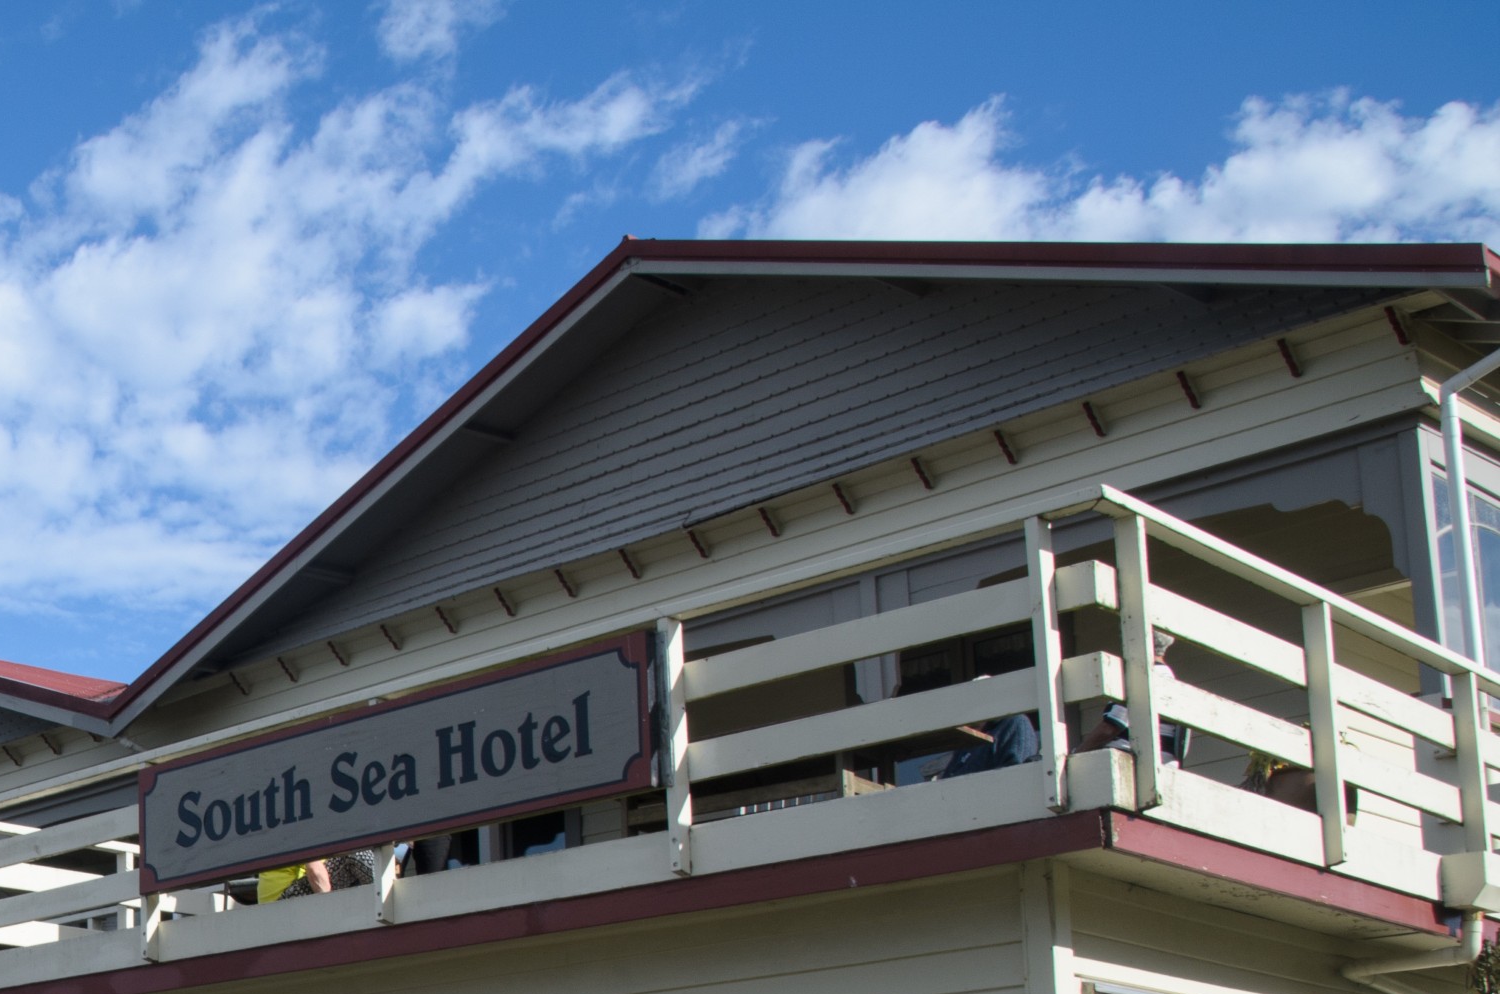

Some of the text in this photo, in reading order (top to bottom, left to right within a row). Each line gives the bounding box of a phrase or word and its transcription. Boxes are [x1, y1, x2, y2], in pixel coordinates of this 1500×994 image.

[175, 690, 593, 849] South Sea Hotel
